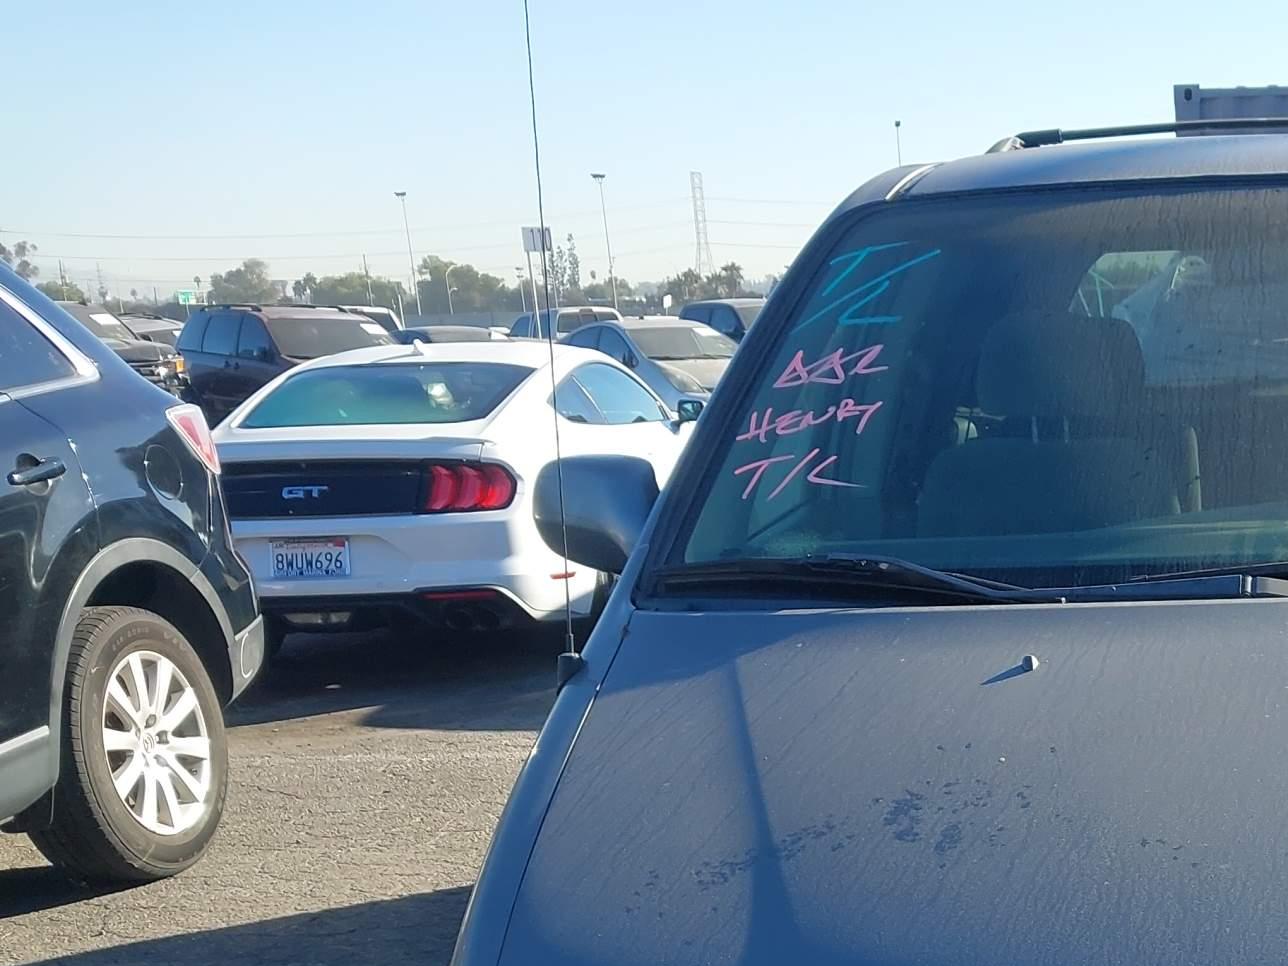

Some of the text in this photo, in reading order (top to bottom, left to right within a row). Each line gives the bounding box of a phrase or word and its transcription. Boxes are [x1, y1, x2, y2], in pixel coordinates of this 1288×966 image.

[736, 398, 883, 443] HENRY
[282, 486, 328, 499] GT
[275, 551, 344, 571] 8WUW696
